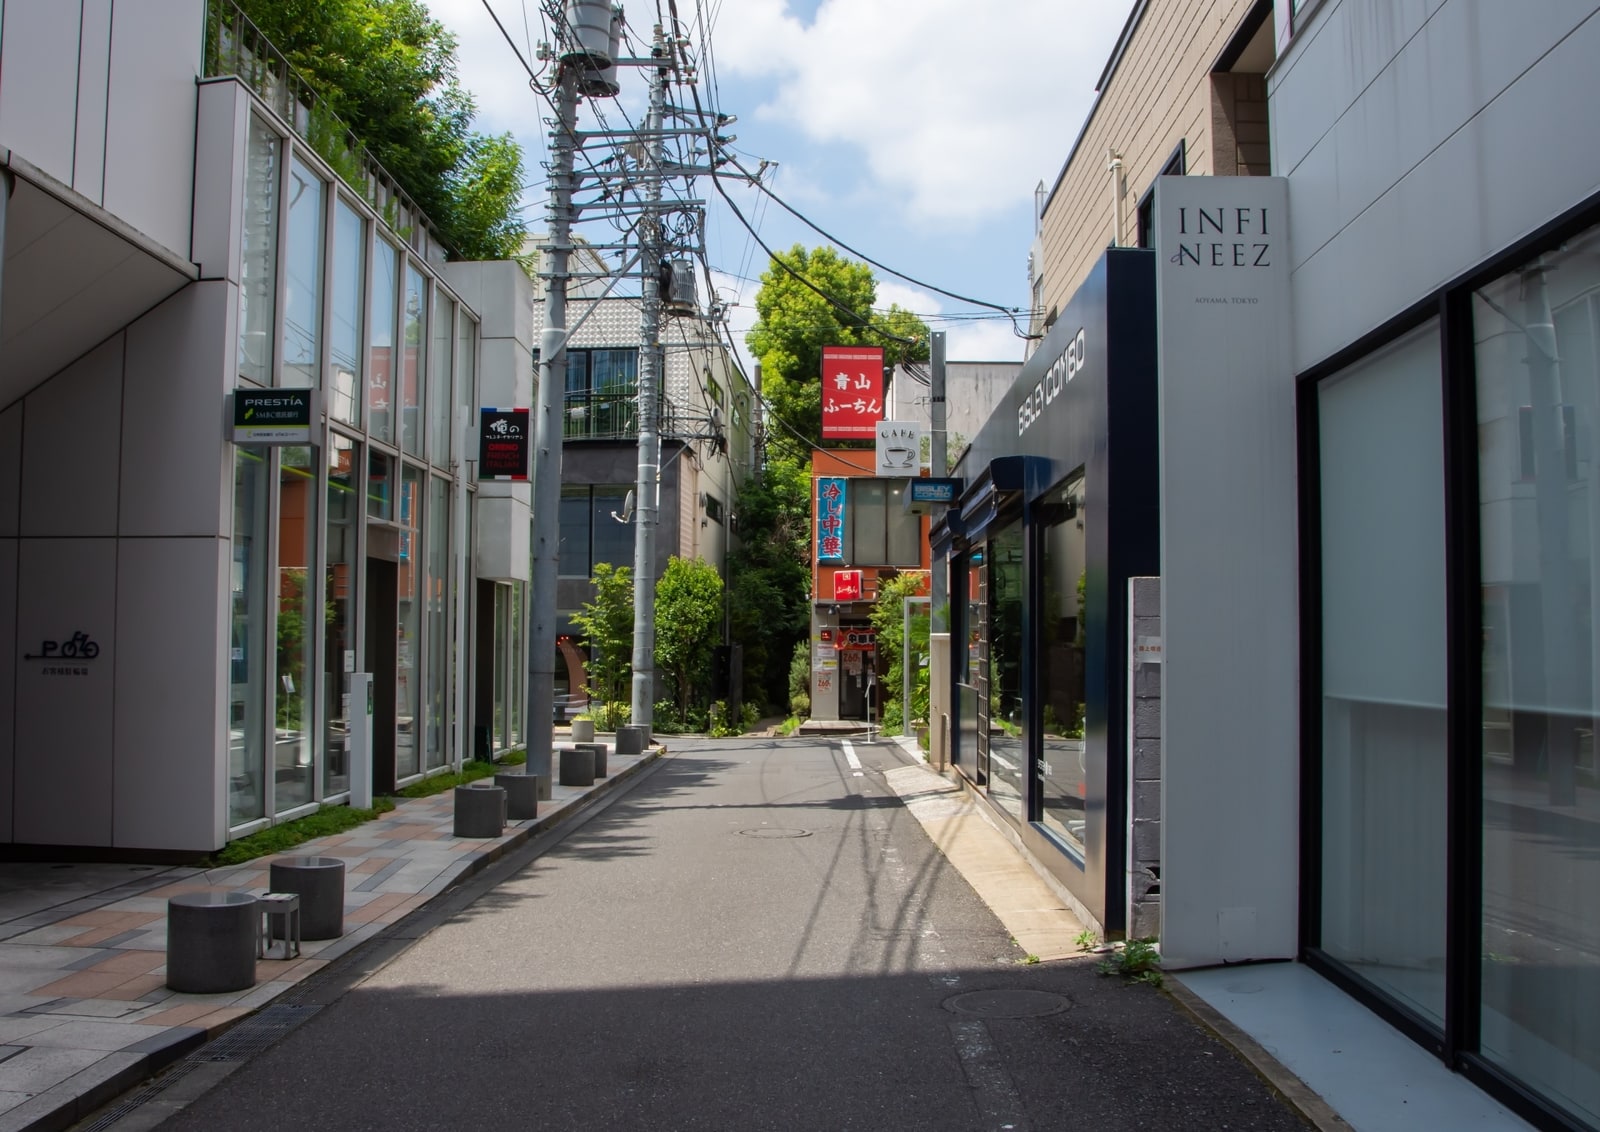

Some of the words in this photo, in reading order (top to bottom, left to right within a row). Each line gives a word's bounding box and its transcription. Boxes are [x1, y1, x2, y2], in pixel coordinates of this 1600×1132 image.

[1179, 207, 1269, 235] INFI
[1176, 243, 1271, 267] NEEZ
[833, 372, 872, 390] 青山
[1018, 377, 1046, 437] BISLEY
[1046, 327, 1085, 406] COMBO
[823, 398, 882, 414] ふーちん
[489, 418, 520, 434] 俺の
[881, 428, 915, 440] CAFE
[822, 482, 842, 558] 冷し中華
[42, 640, 58, 656] P
